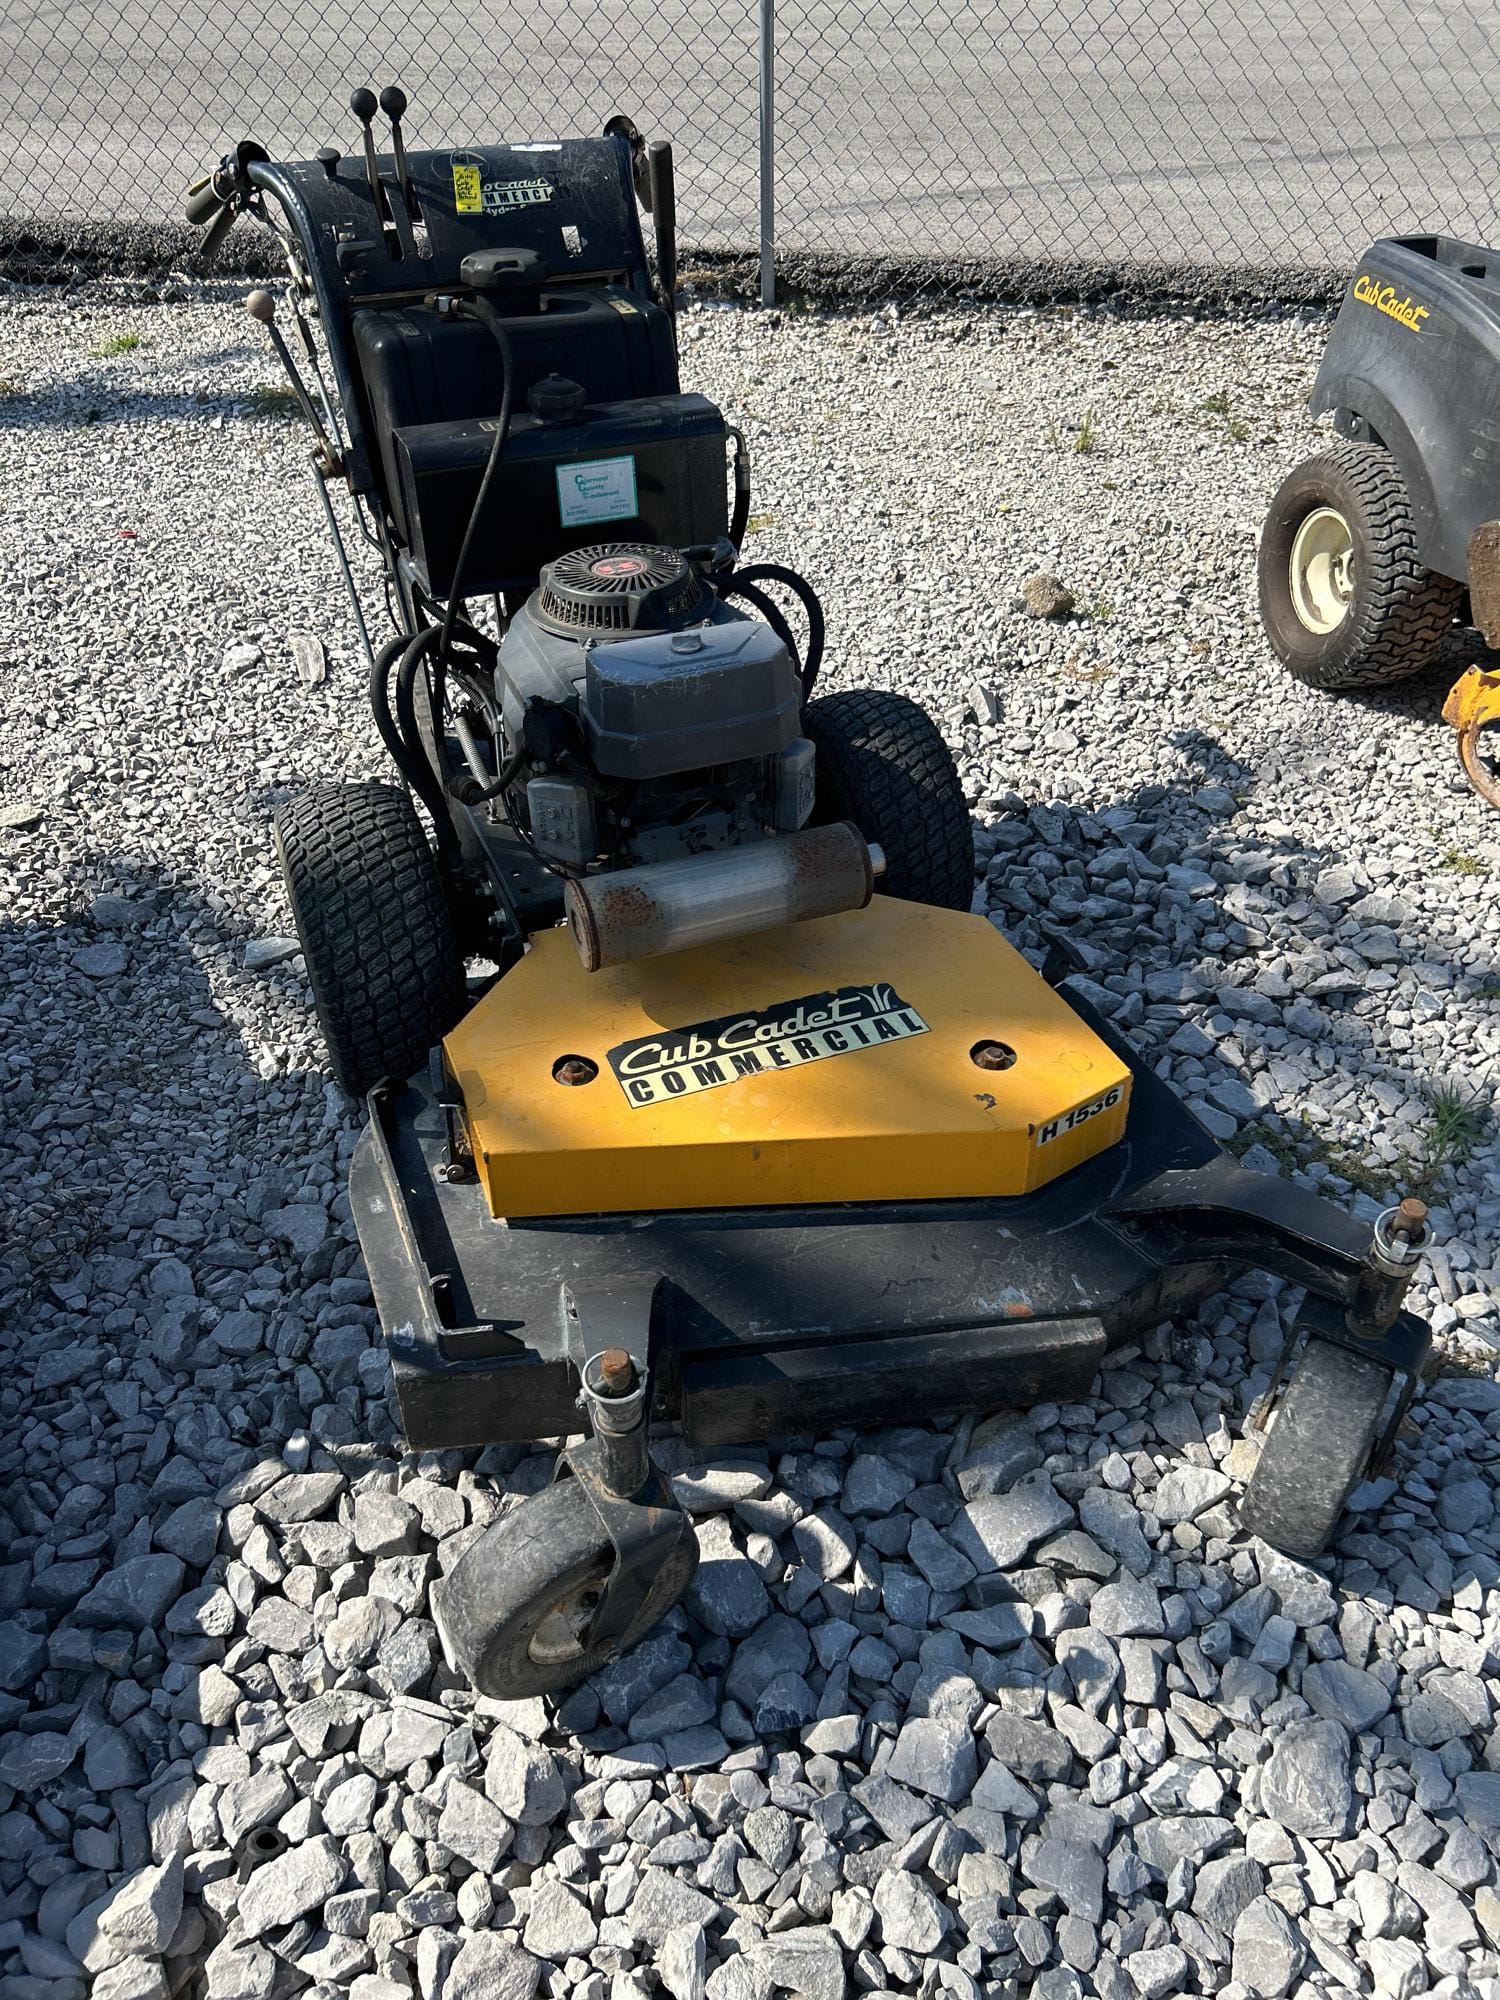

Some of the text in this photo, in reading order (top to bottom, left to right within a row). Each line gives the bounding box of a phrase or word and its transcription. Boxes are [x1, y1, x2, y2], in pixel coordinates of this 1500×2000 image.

[484, 188, 549, 205] MMERCI
[1354, 276, 1431, 332] Cub Cadet
[619, 994, 863, 1075] Cub Cadet
[628, 1012, 925, 1103] COMMERCIAL
[1041, 1121, 1058, 1144] H
